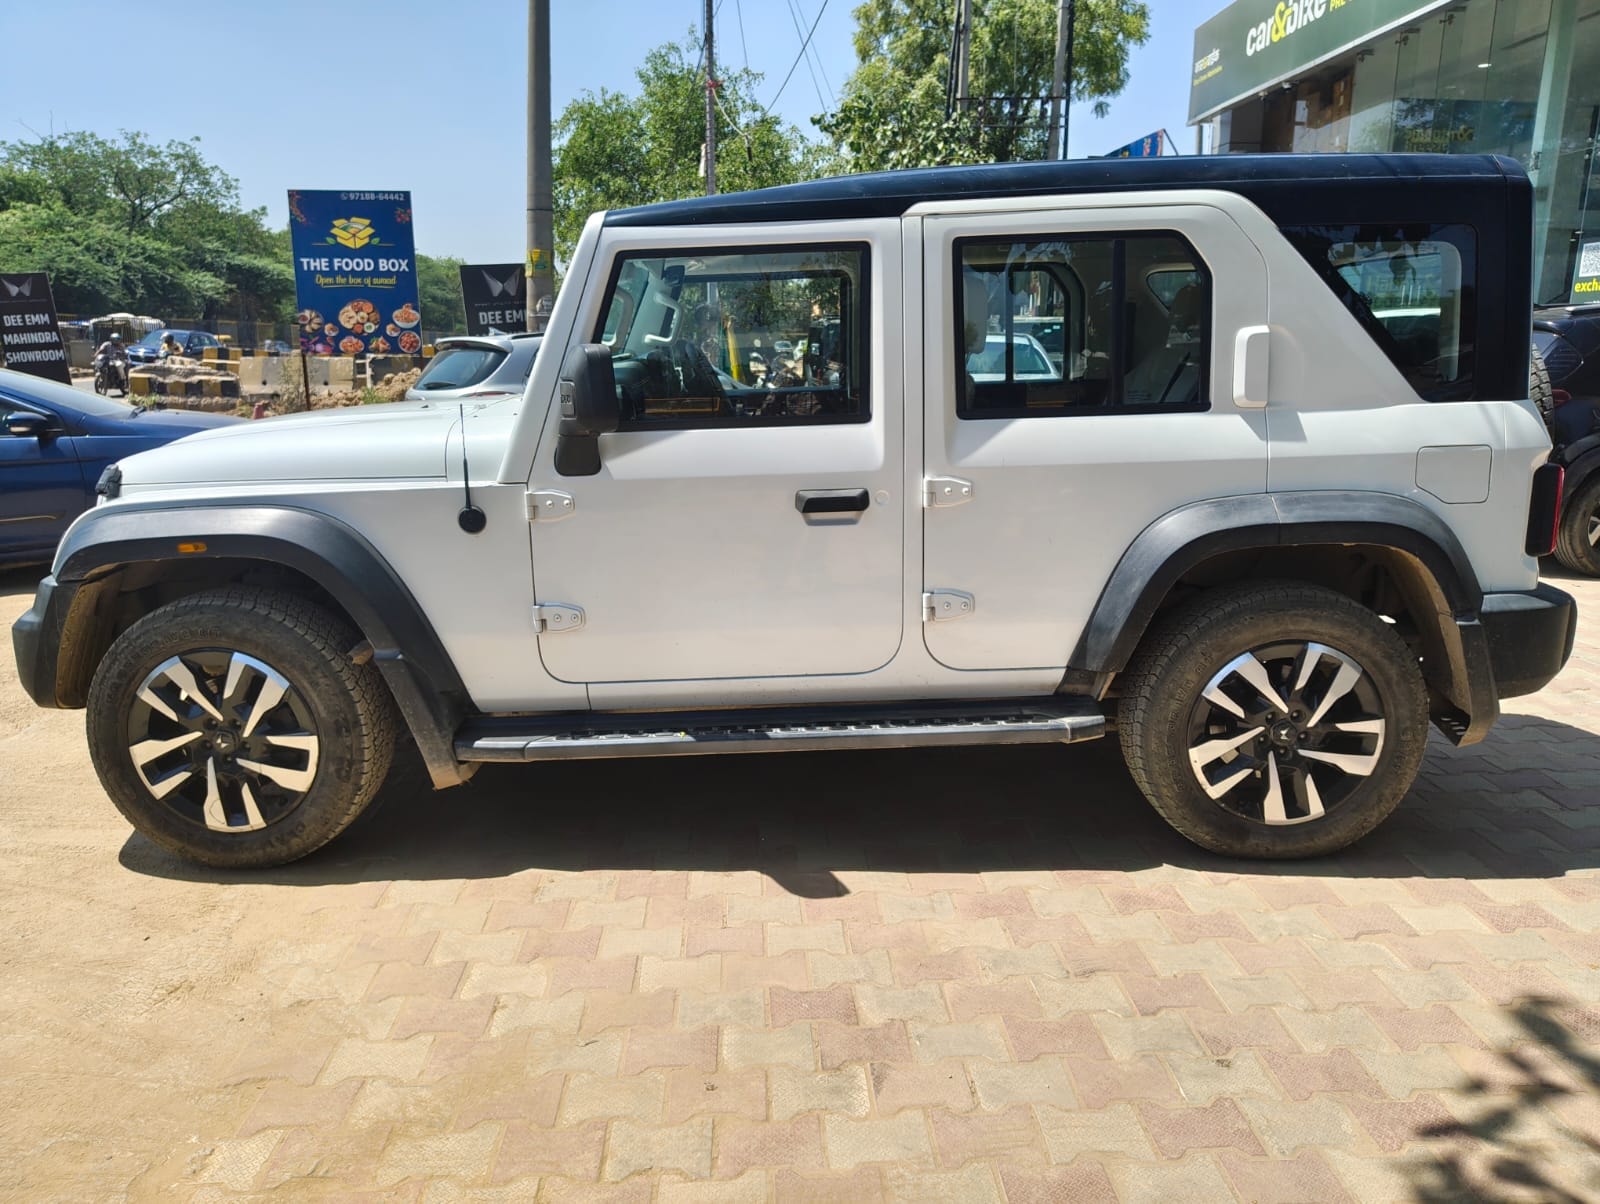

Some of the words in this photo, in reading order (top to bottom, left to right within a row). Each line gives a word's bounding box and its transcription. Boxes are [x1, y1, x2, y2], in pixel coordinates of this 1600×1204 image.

[1246, 0, 1327, 56] car&bike
[300, 258, 330, 271] THE
[334, 258, 375, 271] FOOD
[379, 258, 409, 272] BOX
[315, 273, 334, 287] Open
[336, 274, 347, 284] the
[349, 274, 362, 284] box
[3, 314, 23, 326] DEE
[25, 313, 50, 325] EMM
[478, 311, 503, 325] DEE
[3, 331, 60, 345] MAHINDRA
[6, 349, 65, 364] SHOWROOM
